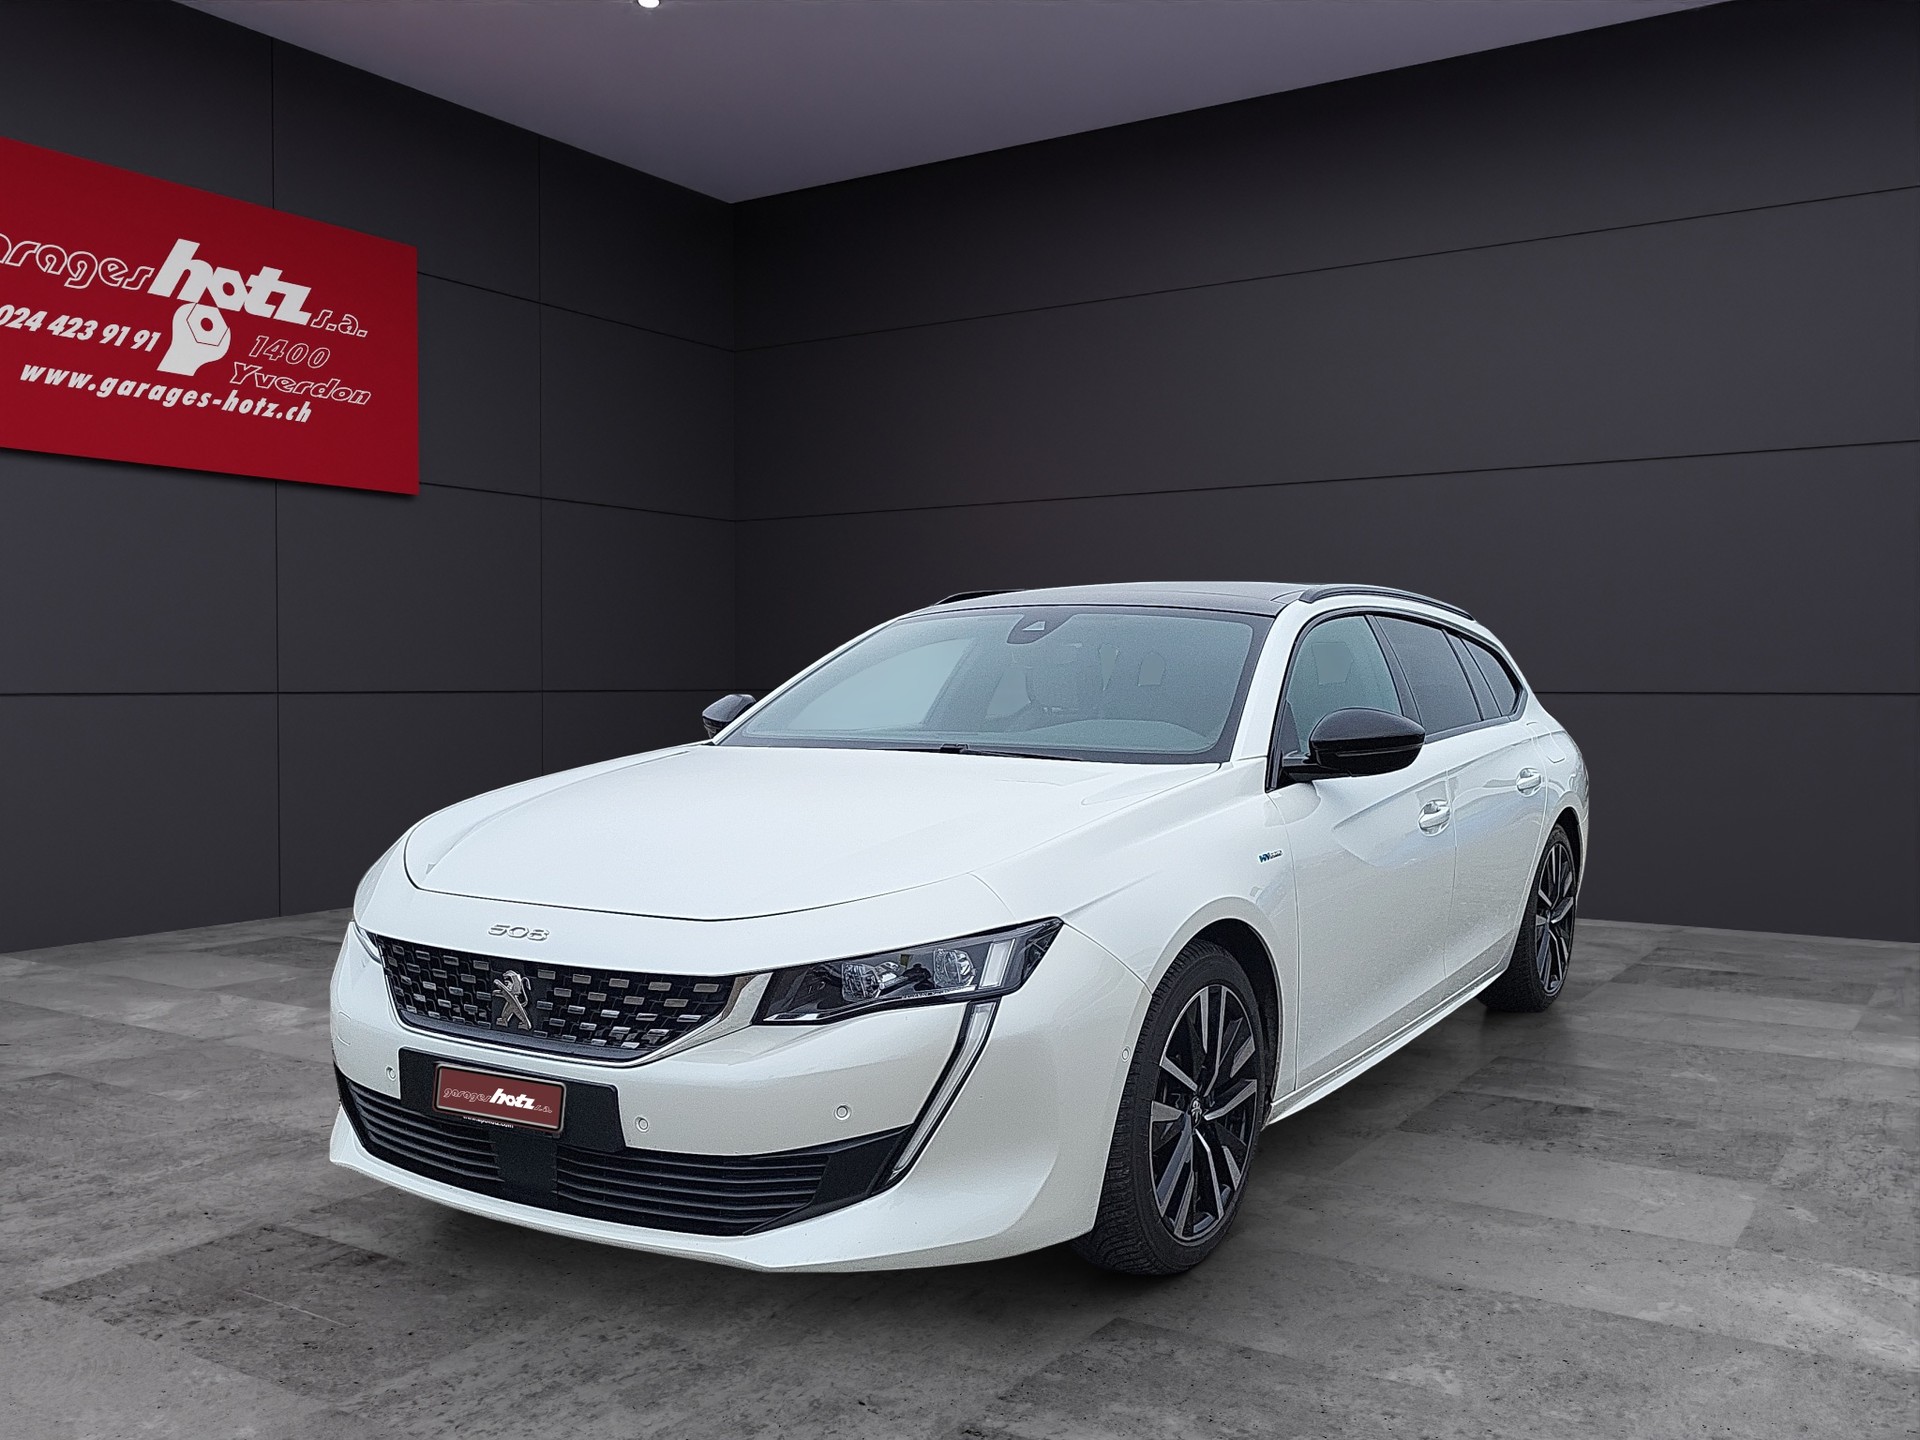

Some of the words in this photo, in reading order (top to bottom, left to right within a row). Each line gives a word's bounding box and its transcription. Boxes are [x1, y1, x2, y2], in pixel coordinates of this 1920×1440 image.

[147, 238, 312, 325] hotz
[0, 304, 48, 332] 024
[47, 314, 99, 341] 423
[99, 323, 131, 347] 91
[130, 329, 162, 352] 91
[249, 335, 331, 369] 1400
[20, 363, 312, 424] www.garages-hotz.ch
[229, 361, 372, 405] Yverdon
[488, 924, 550, 941] 508
[443, 1087, 491, 1103] garages
[489, 1087, 536, 1110] hotz
